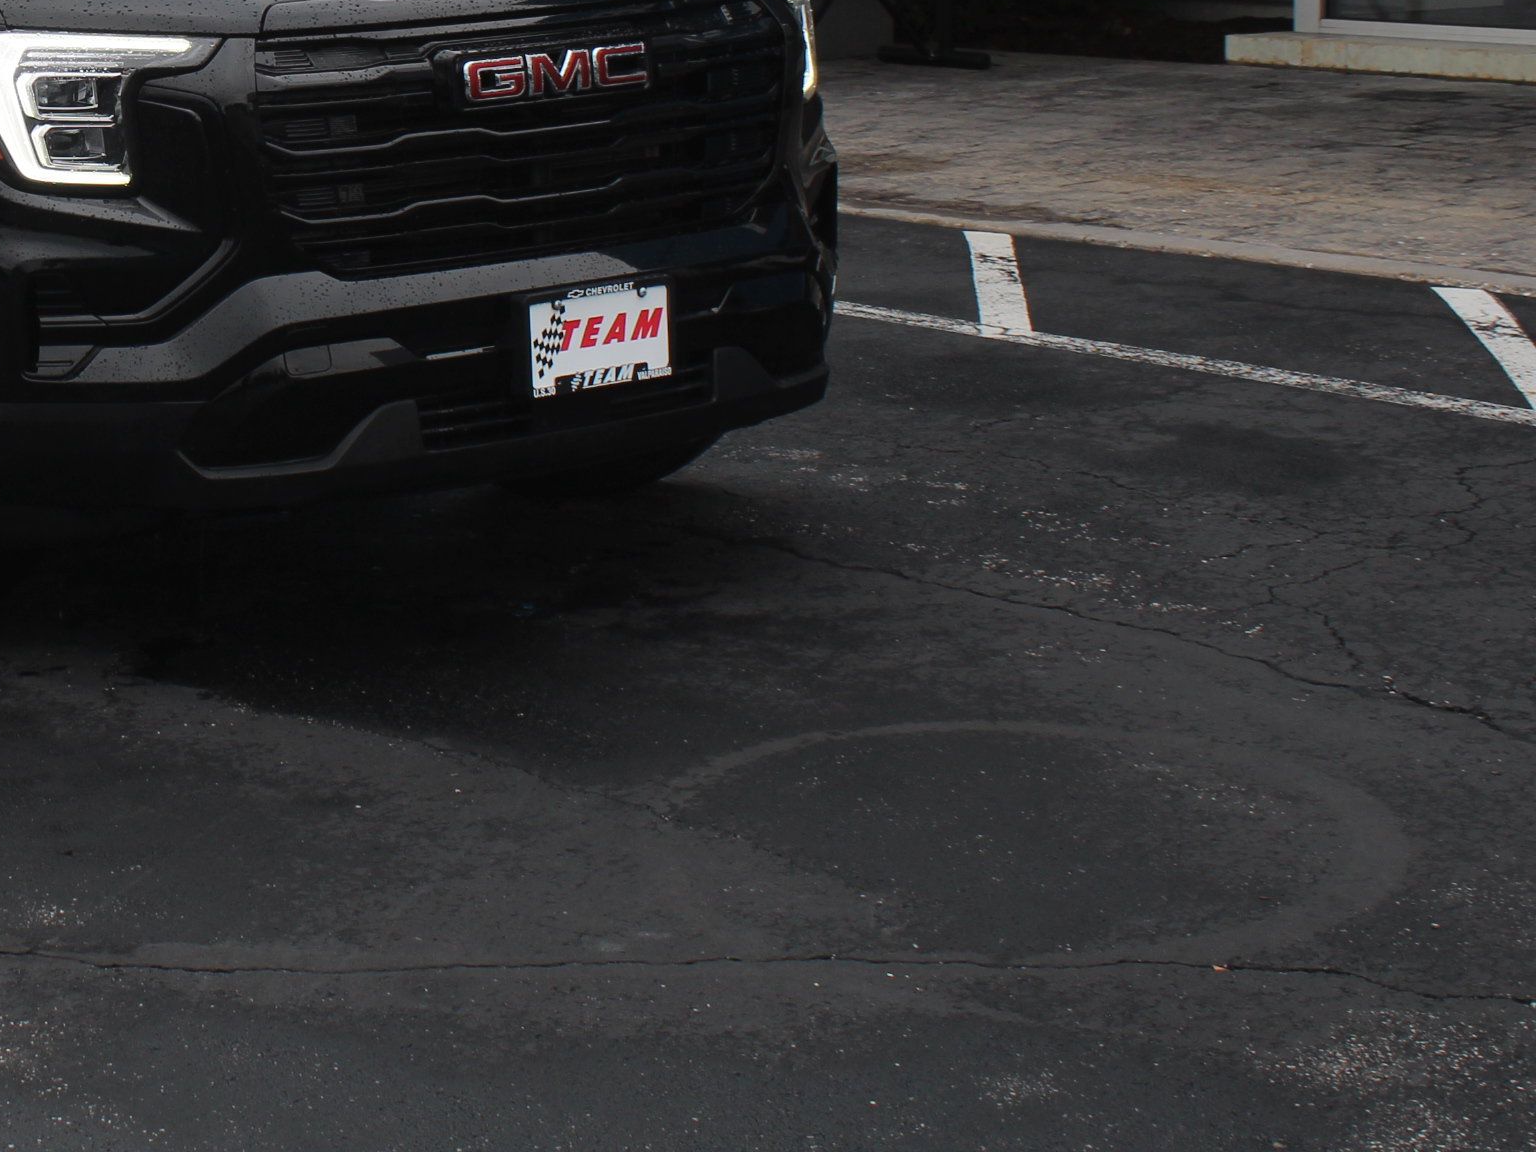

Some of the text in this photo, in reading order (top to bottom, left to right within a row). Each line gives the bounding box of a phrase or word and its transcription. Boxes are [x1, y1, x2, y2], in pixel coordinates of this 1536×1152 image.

[463, 41, 651, 102] GMC
[585, 281, 635, 297] CHEVROLET
[559, 307, 664, 352] TEAM
[581, 363, 636, 388] TEAM
